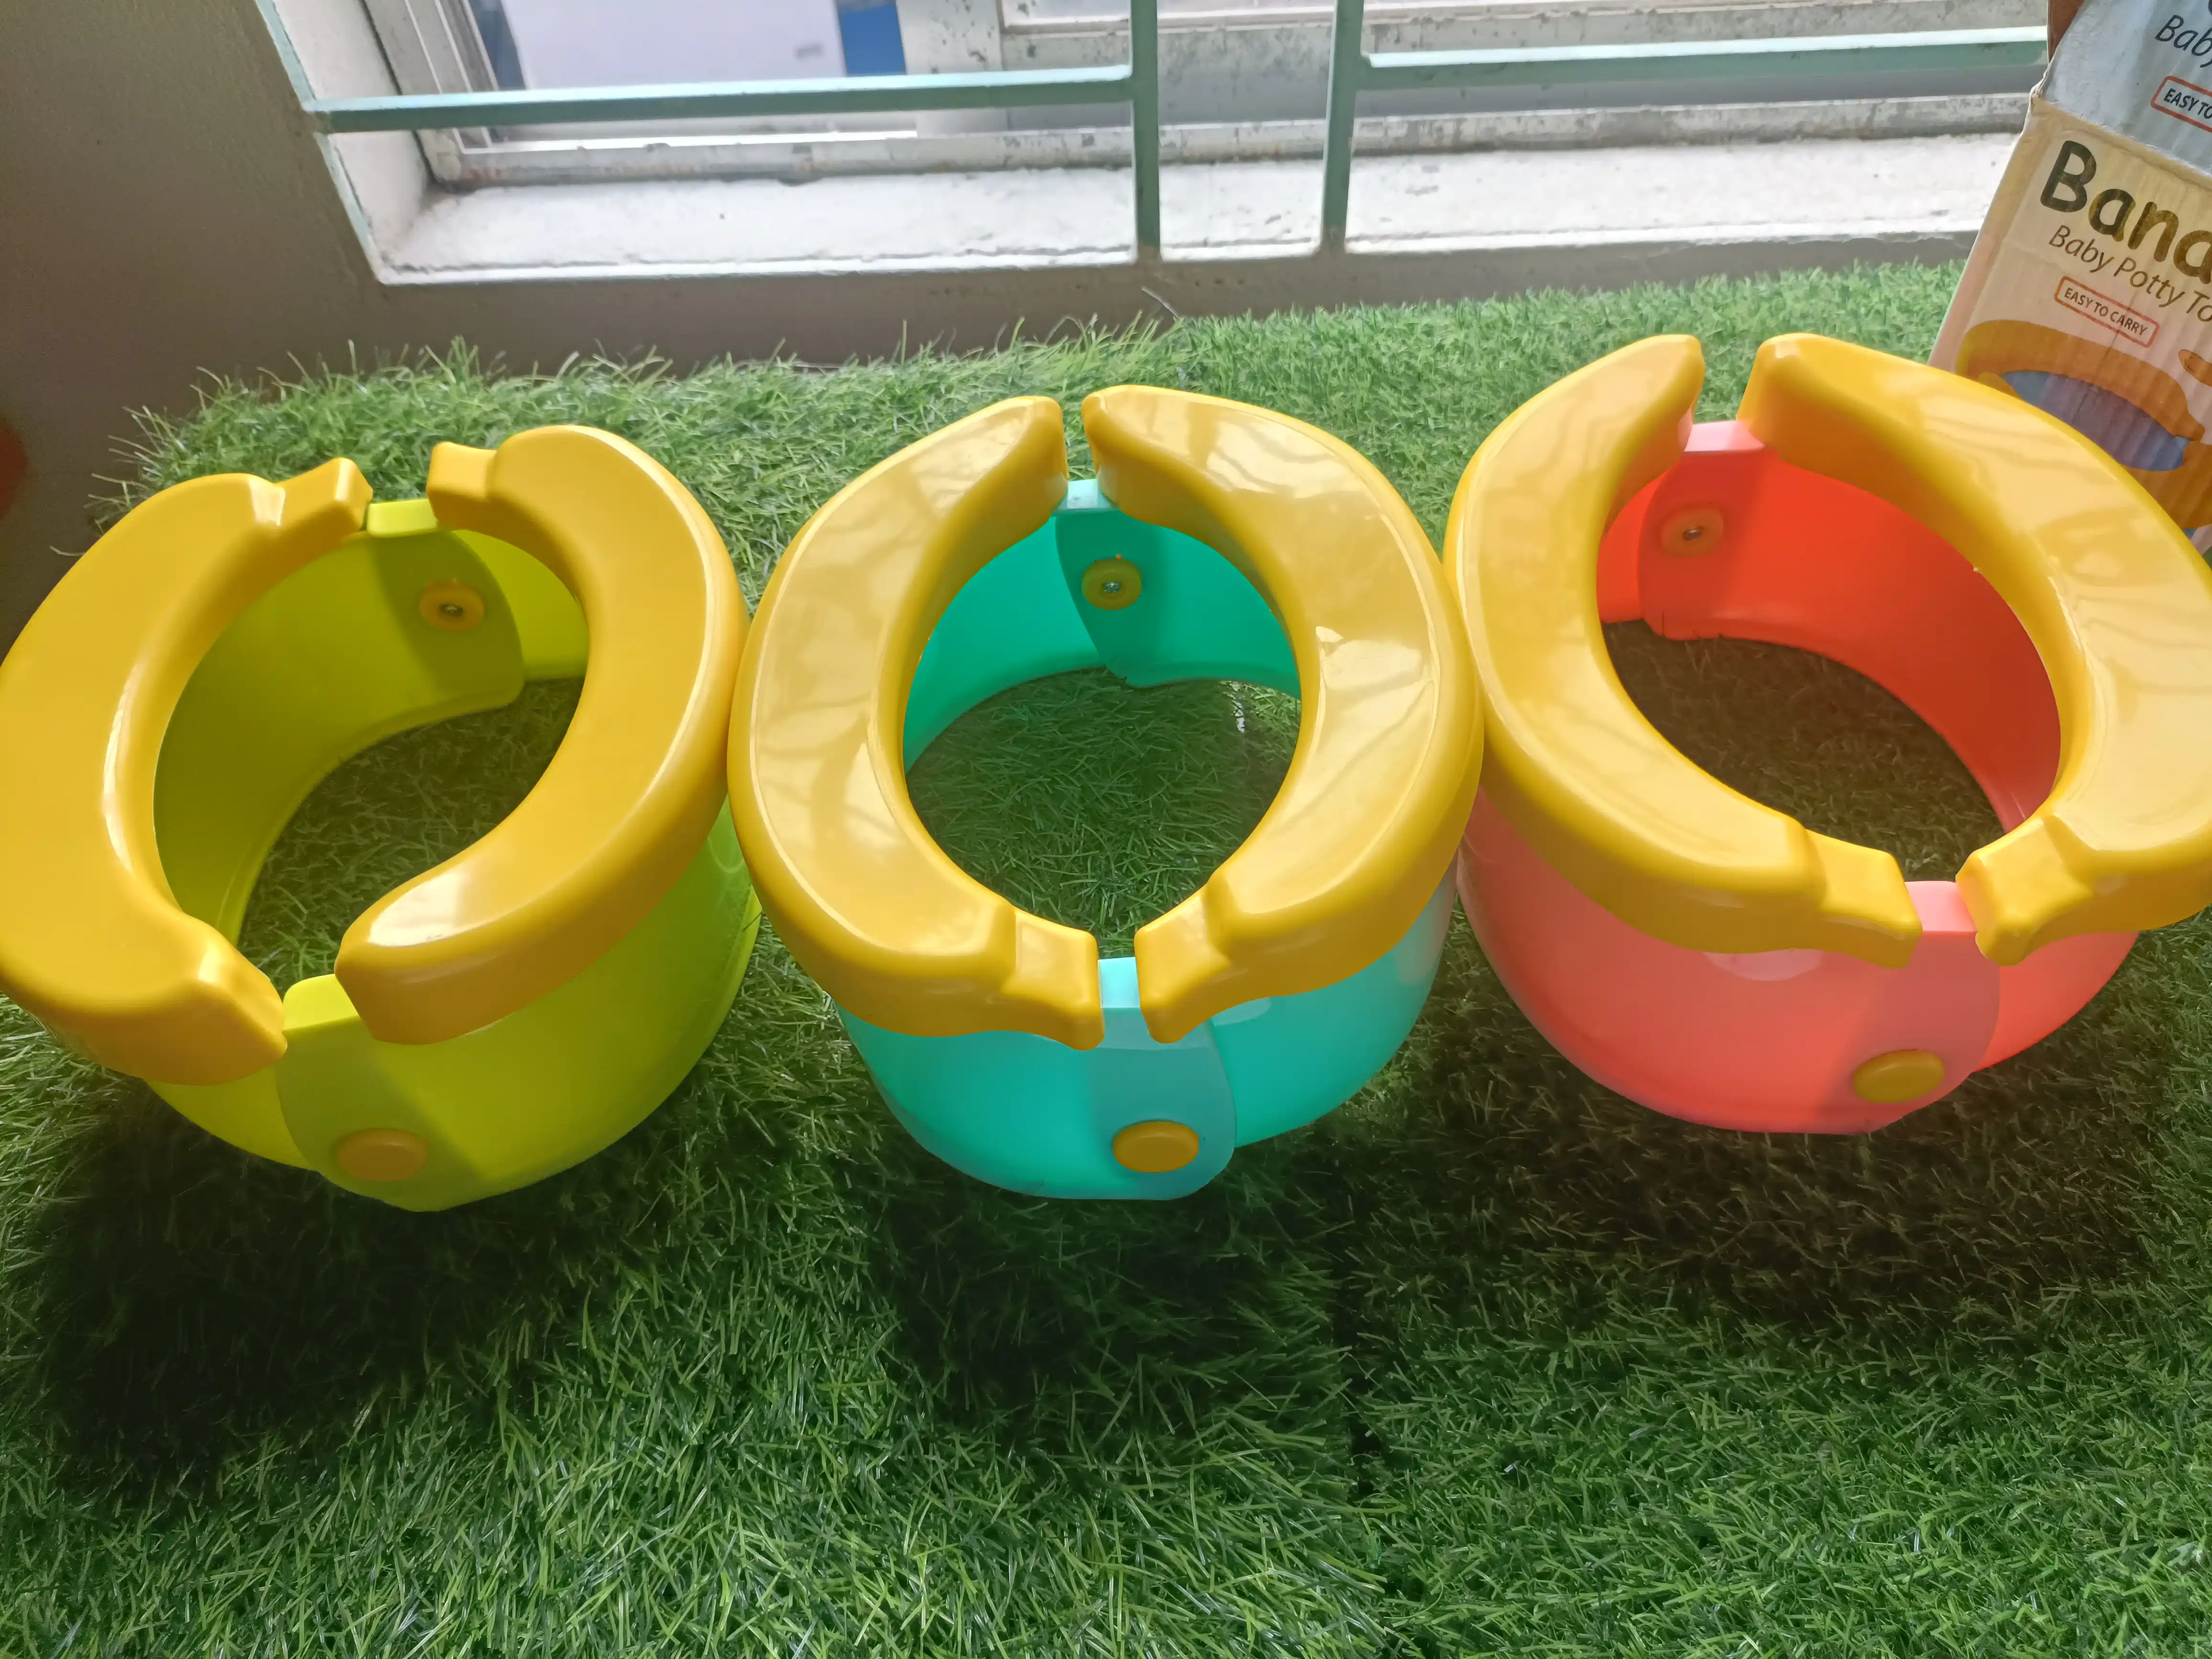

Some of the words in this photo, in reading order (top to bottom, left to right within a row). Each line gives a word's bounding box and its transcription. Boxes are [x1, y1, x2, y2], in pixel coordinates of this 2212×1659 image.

[2164, 88, 2200, 111] EASY
[2197, 101, 2212, 119] TO
[2048, 224, 2115, 273] Baby
[2112, 257, 2185, 308] Potty
[2186, 290, 2212, 322] To
[2064, 287, 2093, 309] EASY
[2093, 301, 2109, 317] TO
[2110, 311, 2150, 336] CARRY
